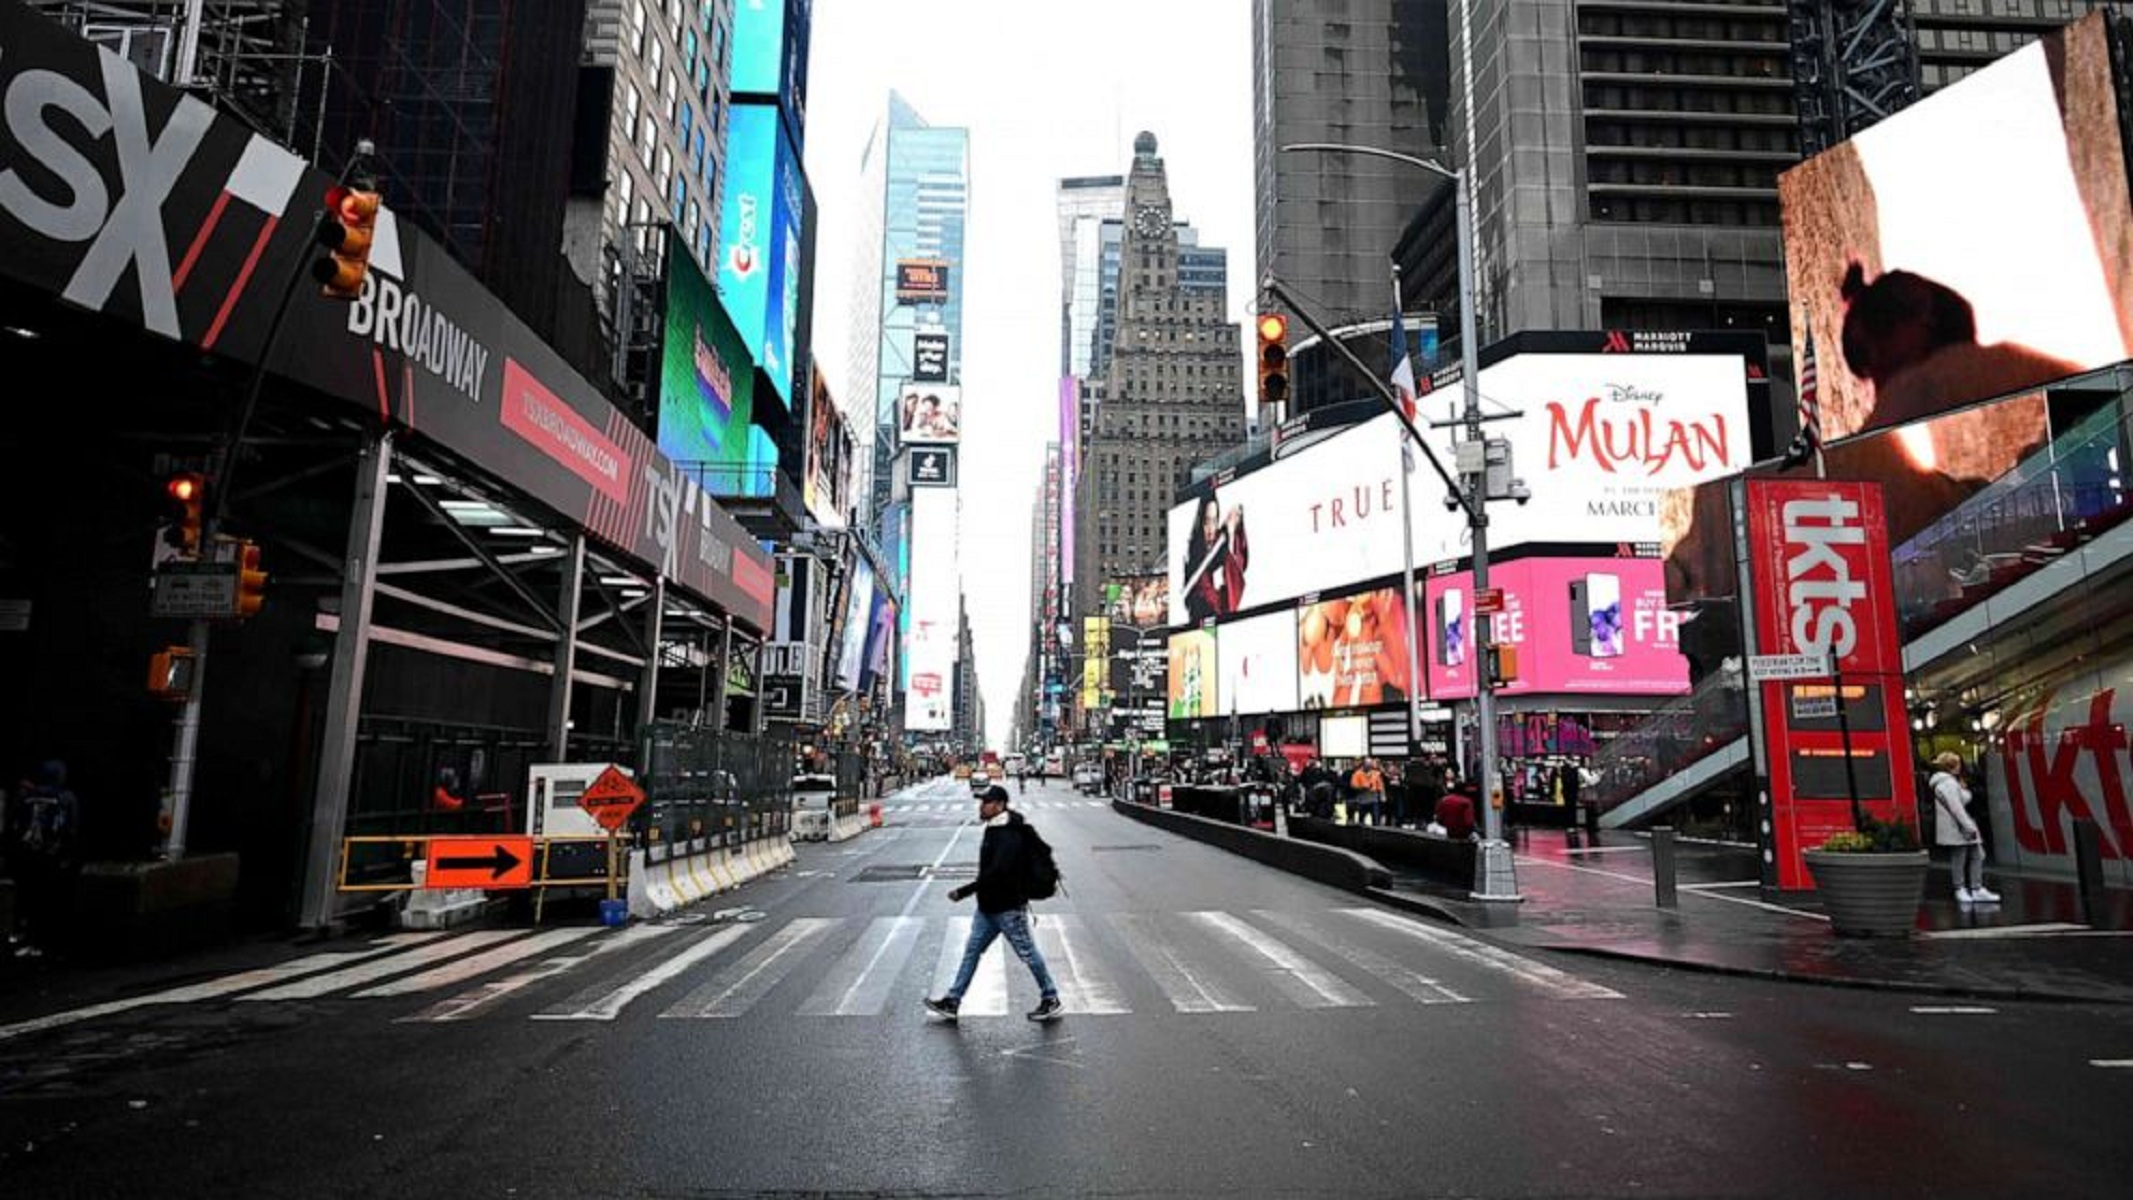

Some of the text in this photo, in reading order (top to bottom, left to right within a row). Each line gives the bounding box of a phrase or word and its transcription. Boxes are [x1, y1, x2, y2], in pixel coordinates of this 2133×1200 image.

[0, 44, 219, 341] SX
[733, 193, 758, 272] Crest
[347, 271, 488, 402] BROADWAY
[1634, 332, 1692, 342] MARRIOTT
[1634, 342, 1687, 351] MARQUIS
[1605, 383, 1663, 405] Disney
[645, 460, 686, 583] TSX
[1309, 479, 1394, 533] TRUE
[1782, 492, 1868, 659] tkts
[1634, 611, 1681, 643] FR
[1997, 684, 2133, 861] tkt
